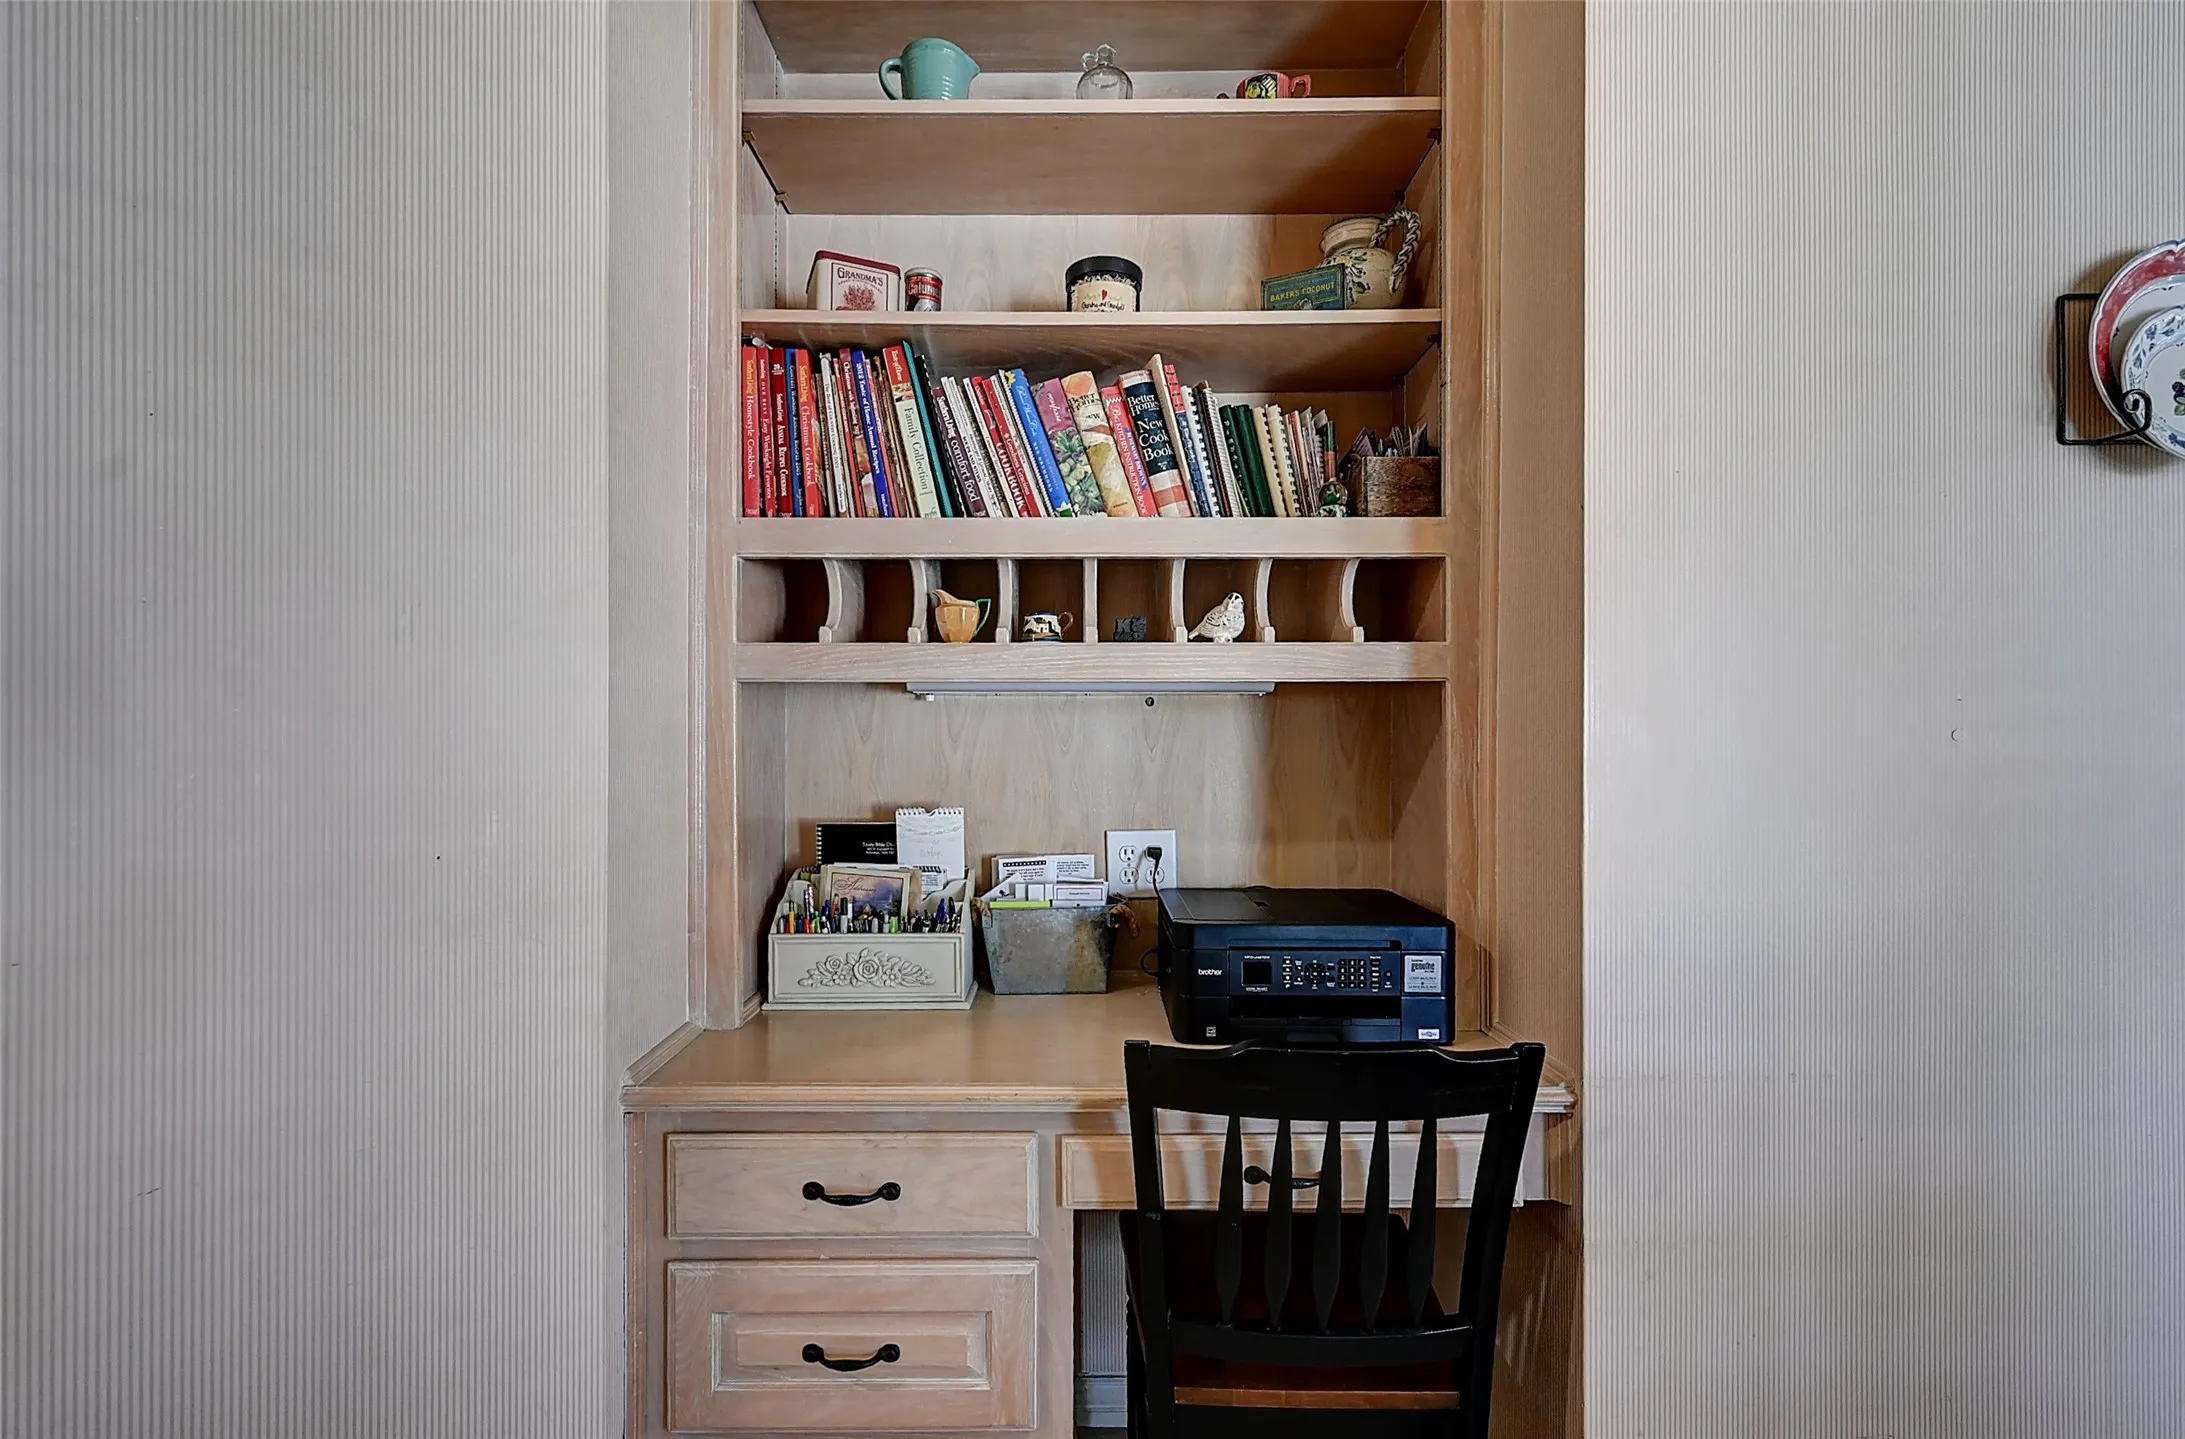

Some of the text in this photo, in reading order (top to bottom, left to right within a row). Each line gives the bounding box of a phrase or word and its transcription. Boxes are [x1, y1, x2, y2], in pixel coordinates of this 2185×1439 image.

[837, 267, 883, 286] GRANDMA'S
[1302, 282, 1335, 294] COCONUT
[855, 362, 863, 378] 2012
[1068, 392, 1095, 405] Better
[1127, 394, 1155, 407] Better
[1130, 400, 1159, 417] Homes
[745, 395, 754, 435] Homestyle
[800, 405, 811, 446] Christmas
[863, 406, 872, 424] Home
[1138, 419, 1163, 433] New
[866, 425, 876, 448] Annual
[936, 395, 978, 501] Southern Living comfort food
[1138, 432, 1169, 447] Cook
[746, 438, 755, 479] Cookbook
[762, 435, 770, 468] Weeknight
[904, 407, 917, 440] Family
[912, 441, 928, 490] Collection
[1143, 447, 1173, 462] Book
[803, 447, 814, 486] Cookbook
[870, 449, 880, 474] Recipes
[1005, 438, 1031, 495] Goodness Gracious
[1115, 423, 1128, 451] KITCHEN
[1124, 452, 1141, 494] INSTRUCTION
[1136, 495, 1147, 514] BOOK
[996, 442, 1025, 507] COOKBOOK
[1411, 962, 1435, 972] genuine
